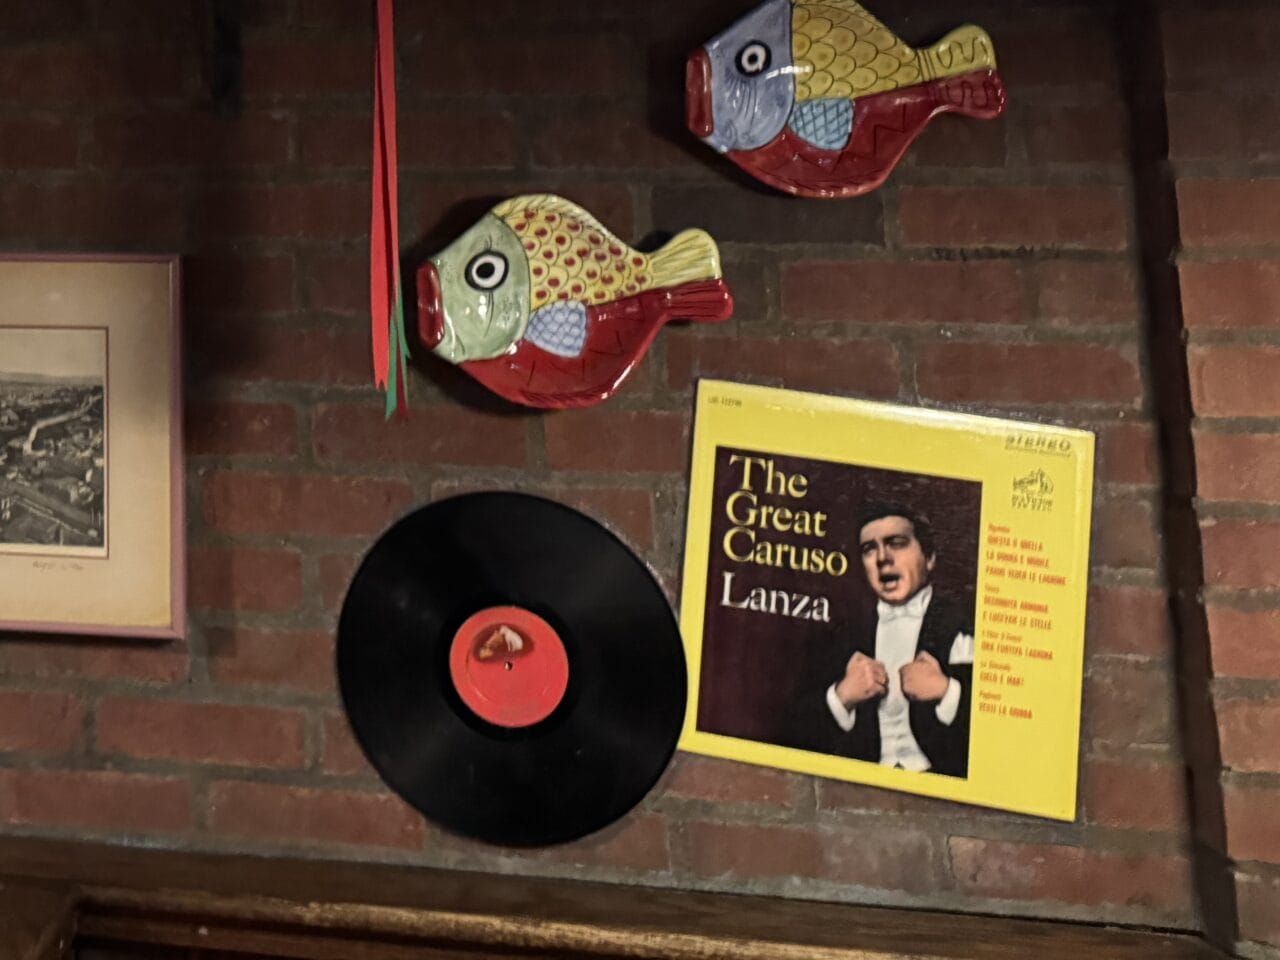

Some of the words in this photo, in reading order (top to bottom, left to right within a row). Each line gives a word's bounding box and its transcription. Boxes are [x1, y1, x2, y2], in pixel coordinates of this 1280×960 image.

[728, 454, 809, 498] The
[725, 490, 827, 538] Great
[722, 526, 848, 577] Caruso
[720, 571, 831, 623] Lanza
